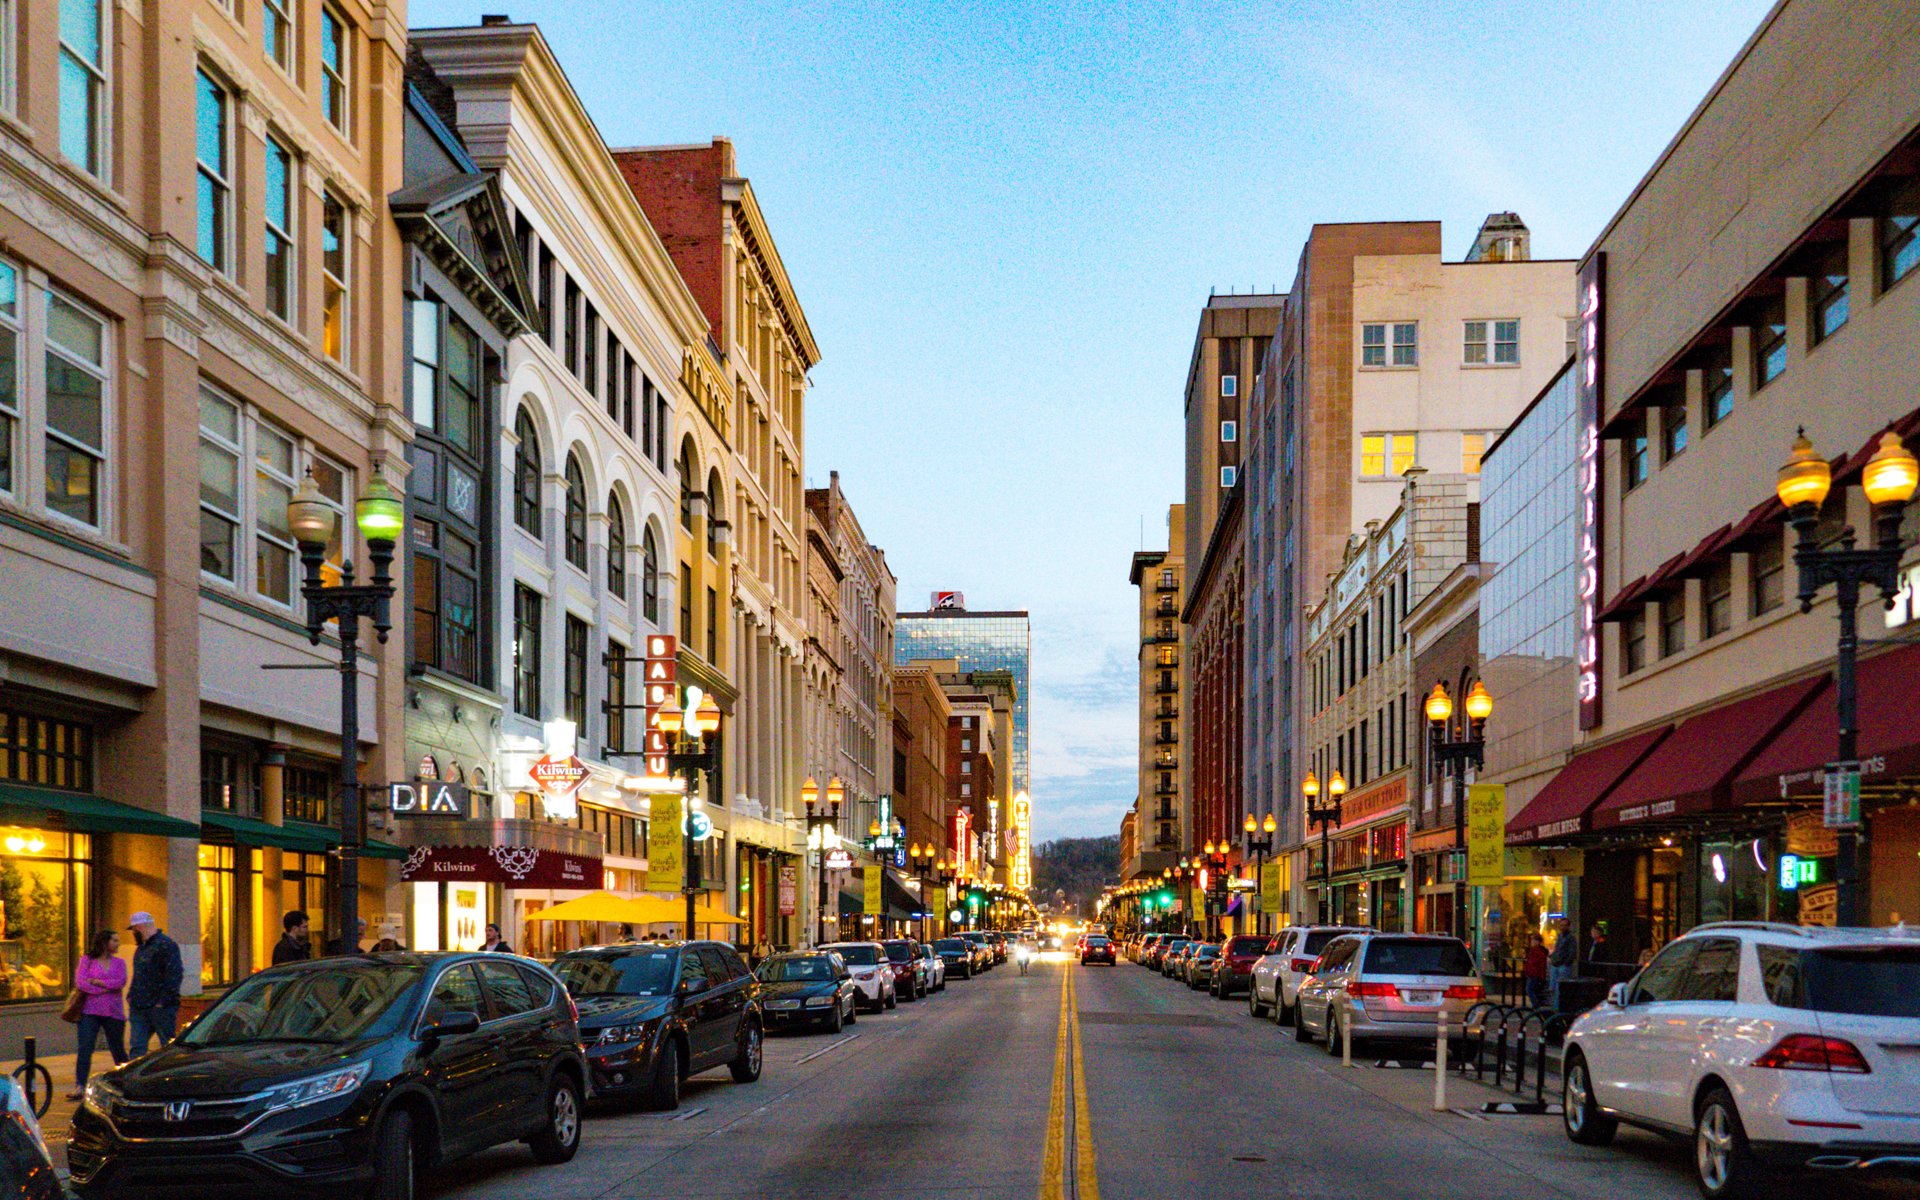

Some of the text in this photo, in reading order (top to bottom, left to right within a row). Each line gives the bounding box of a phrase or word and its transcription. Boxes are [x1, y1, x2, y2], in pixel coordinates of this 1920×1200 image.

[537, 764, 583, 775] Kilwins
[392, 784, 458, 811] DIA
[433, 861, 477, 873] Kilwins
